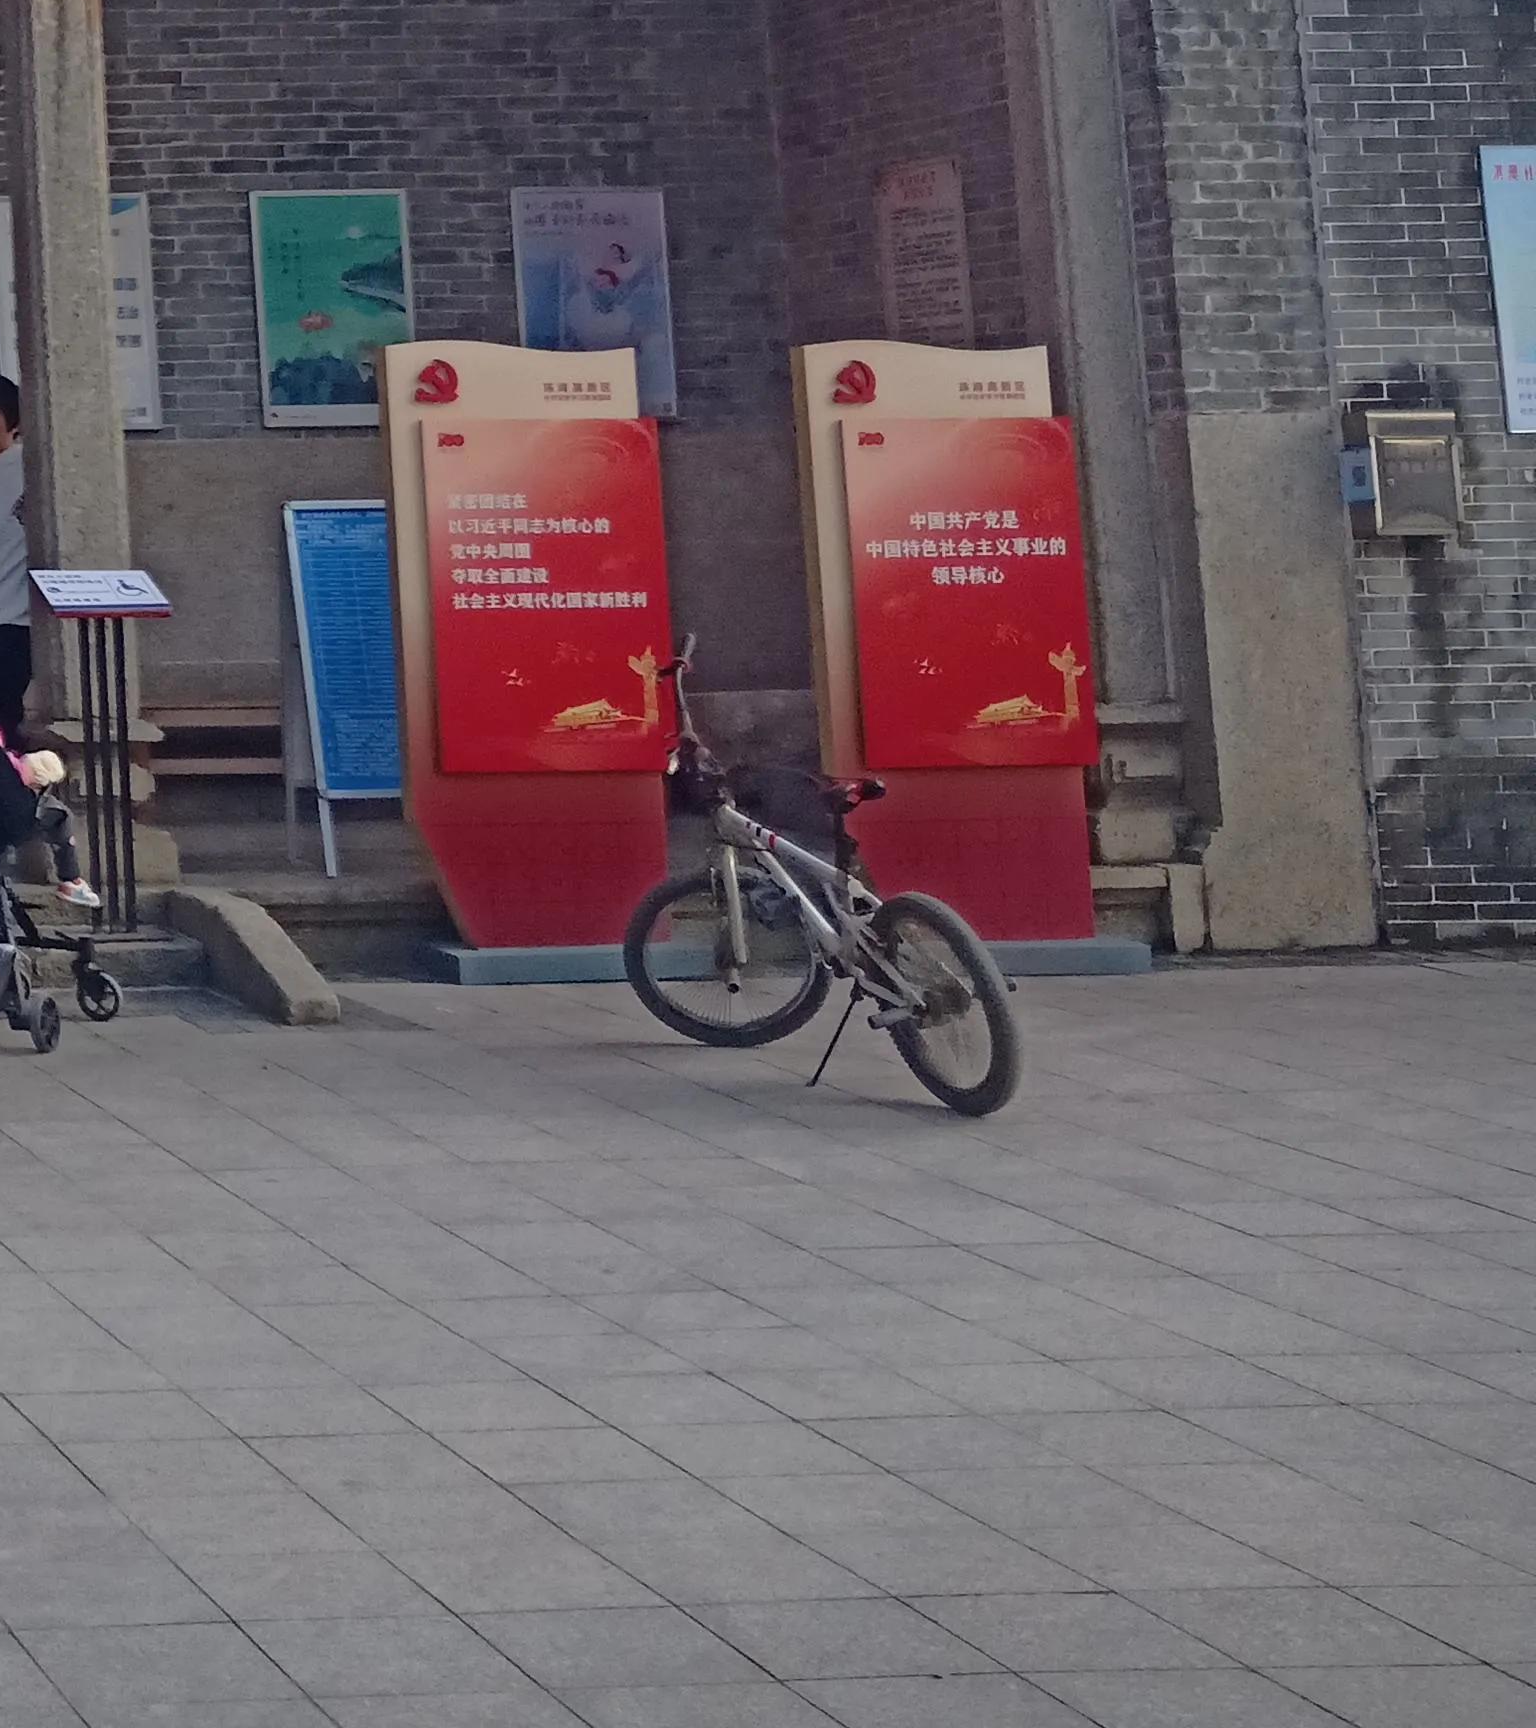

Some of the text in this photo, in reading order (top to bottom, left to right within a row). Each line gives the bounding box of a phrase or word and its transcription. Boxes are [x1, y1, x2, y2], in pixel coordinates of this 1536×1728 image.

[448, 516, 611, 535] 以习近平同志为核心的
[909, 510, 1020, 531] 中国共产党是
[865, 536, 1067, 559] 中国特色社会主义事业的
[931, 565, 1005, 586] 领导核心
[452, 590, 648, 610] 社会主义现代化国家新胜利
